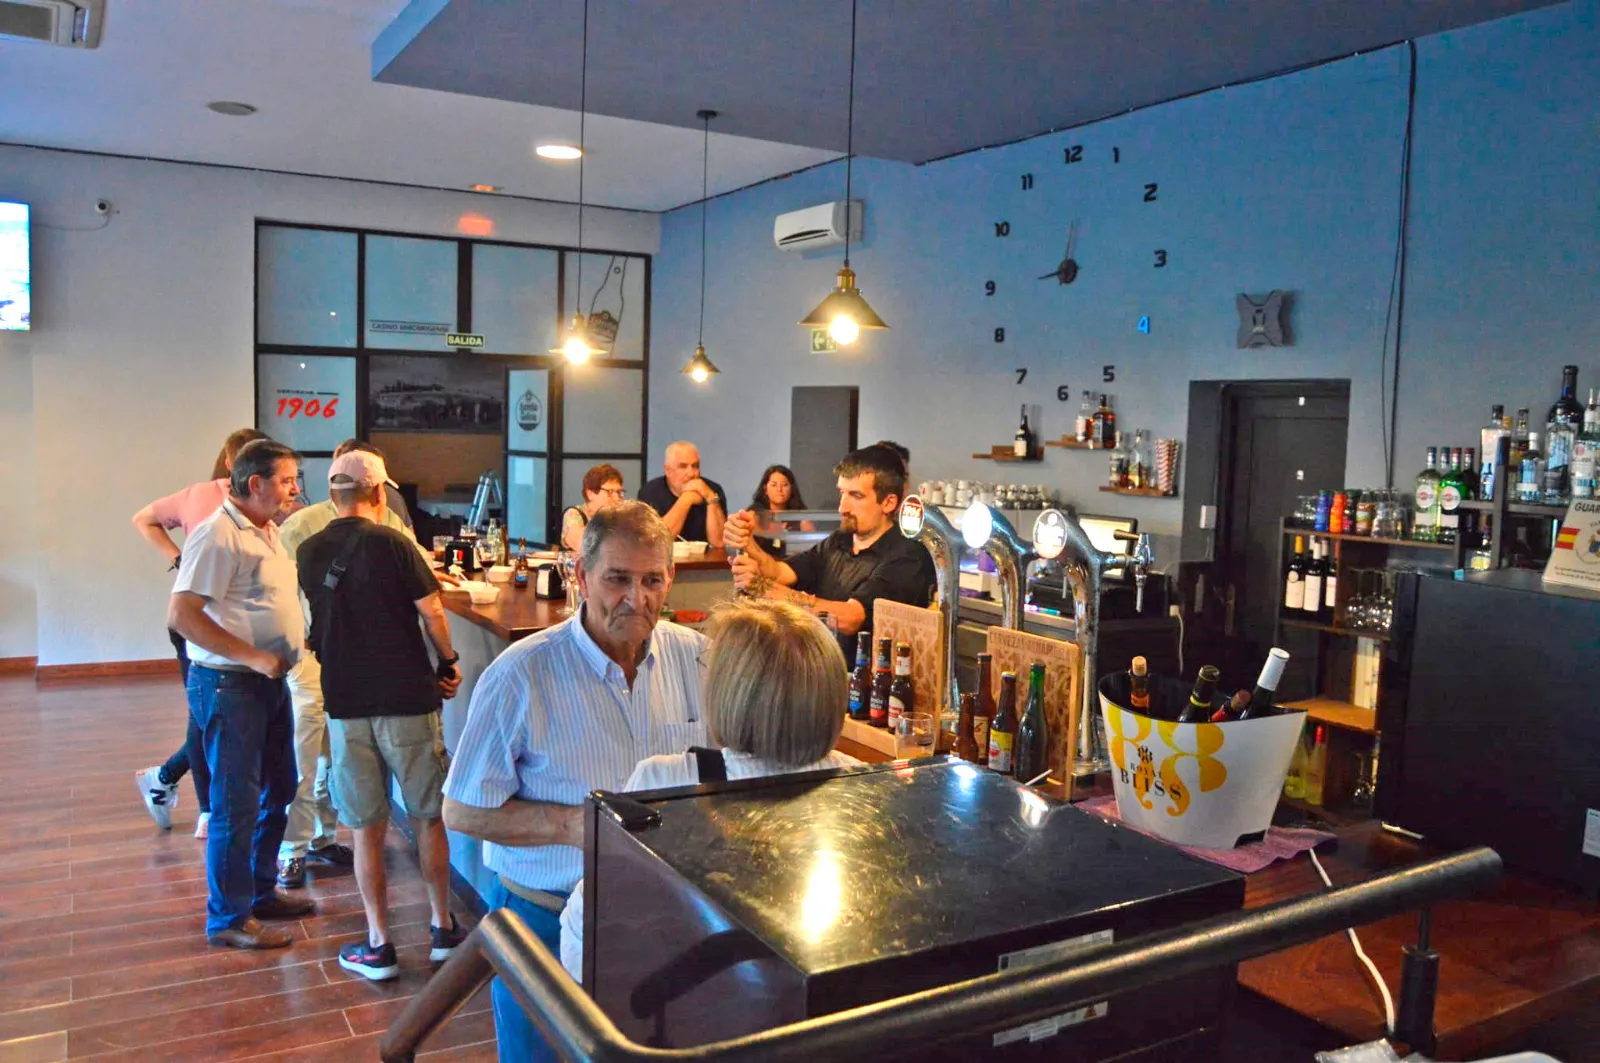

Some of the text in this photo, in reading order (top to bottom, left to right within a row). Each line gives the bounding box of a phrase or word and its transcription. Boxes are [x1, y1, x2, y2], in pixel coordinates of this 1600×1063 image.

[1064, 145, 1083, 163] 12
[1112, 147, 1120, 163] 1
[1021, 173, 1033, 190] 11
[1143, 183, 1158, 202] 2
[994, 220, 1010, 237] 10
[1153, 250, 1167, 267] 3
[985, 280, 996, 296] 9
[1137, 316, 1150, 335] 4
[448, 335, 482, 346] SALIDA
[994, 327, 1005, 343] 8
[1016, 368, 1027, 384] 7
[1103, 365, 1115, 382] 5
[1057, 385, 1069, 401] 6
[276, 397, 339, 420] 1906
[1120, 767, 1182, 800] BLISS
